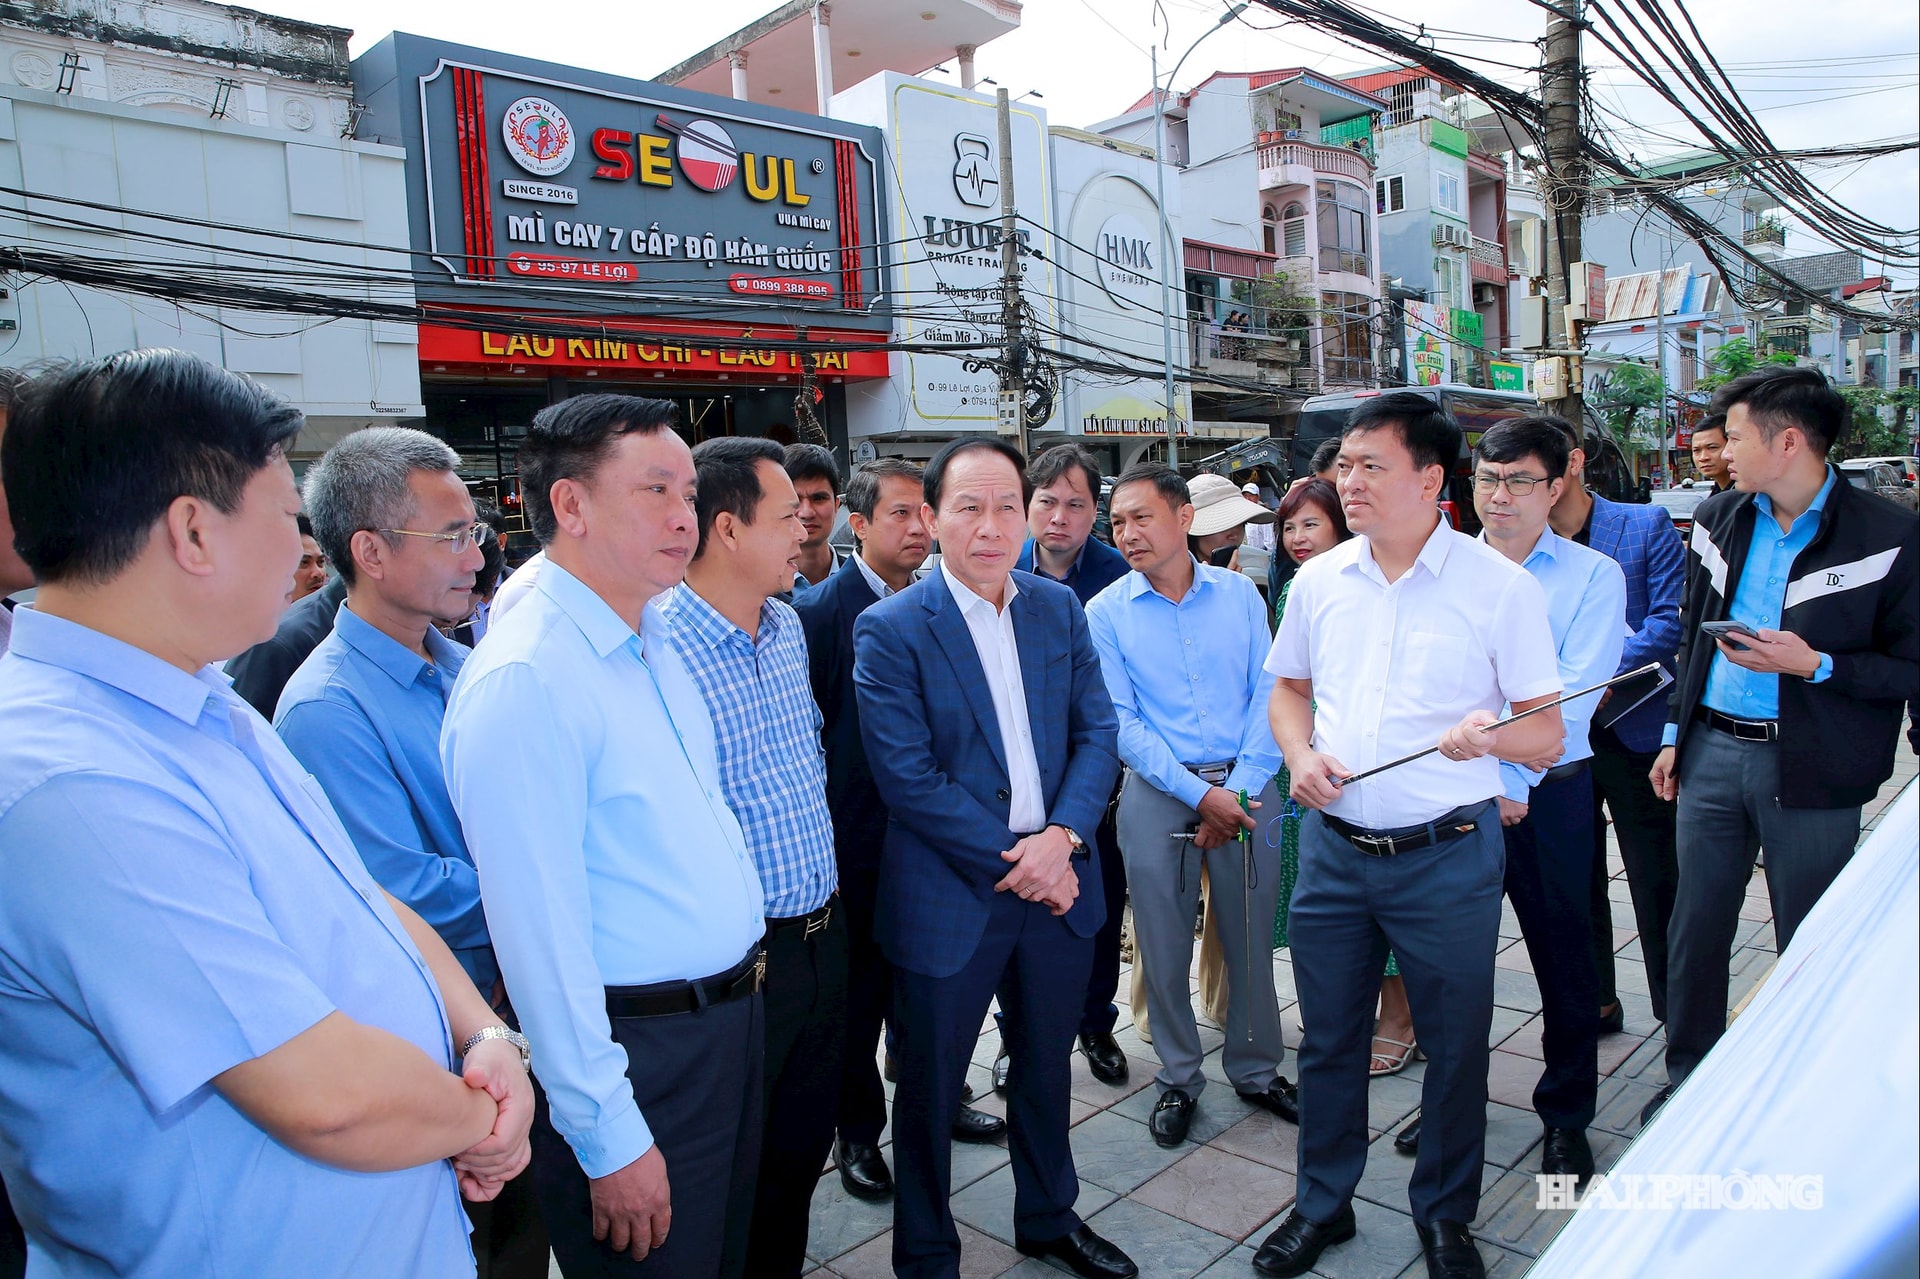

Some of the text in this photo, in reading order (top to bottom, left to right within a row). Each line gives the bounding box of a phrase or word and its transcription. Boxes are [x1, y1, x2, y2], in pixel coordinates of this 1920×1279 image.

[508, 184, 574, 200] SINCE 2016
[777, 213, 832, 231] VUA MÌ CAY
[508, 210, 831, 272] MÌ CAY 7 CẤP ĐỘ HÀN QUỐC
[928, 251, 974, 266] PRIVATE
[1103, 233, 1153, 270] HMK
[752, 279, 828, 297] 0899 388 895
[1247, 450, 1268, 462] VOLVO
